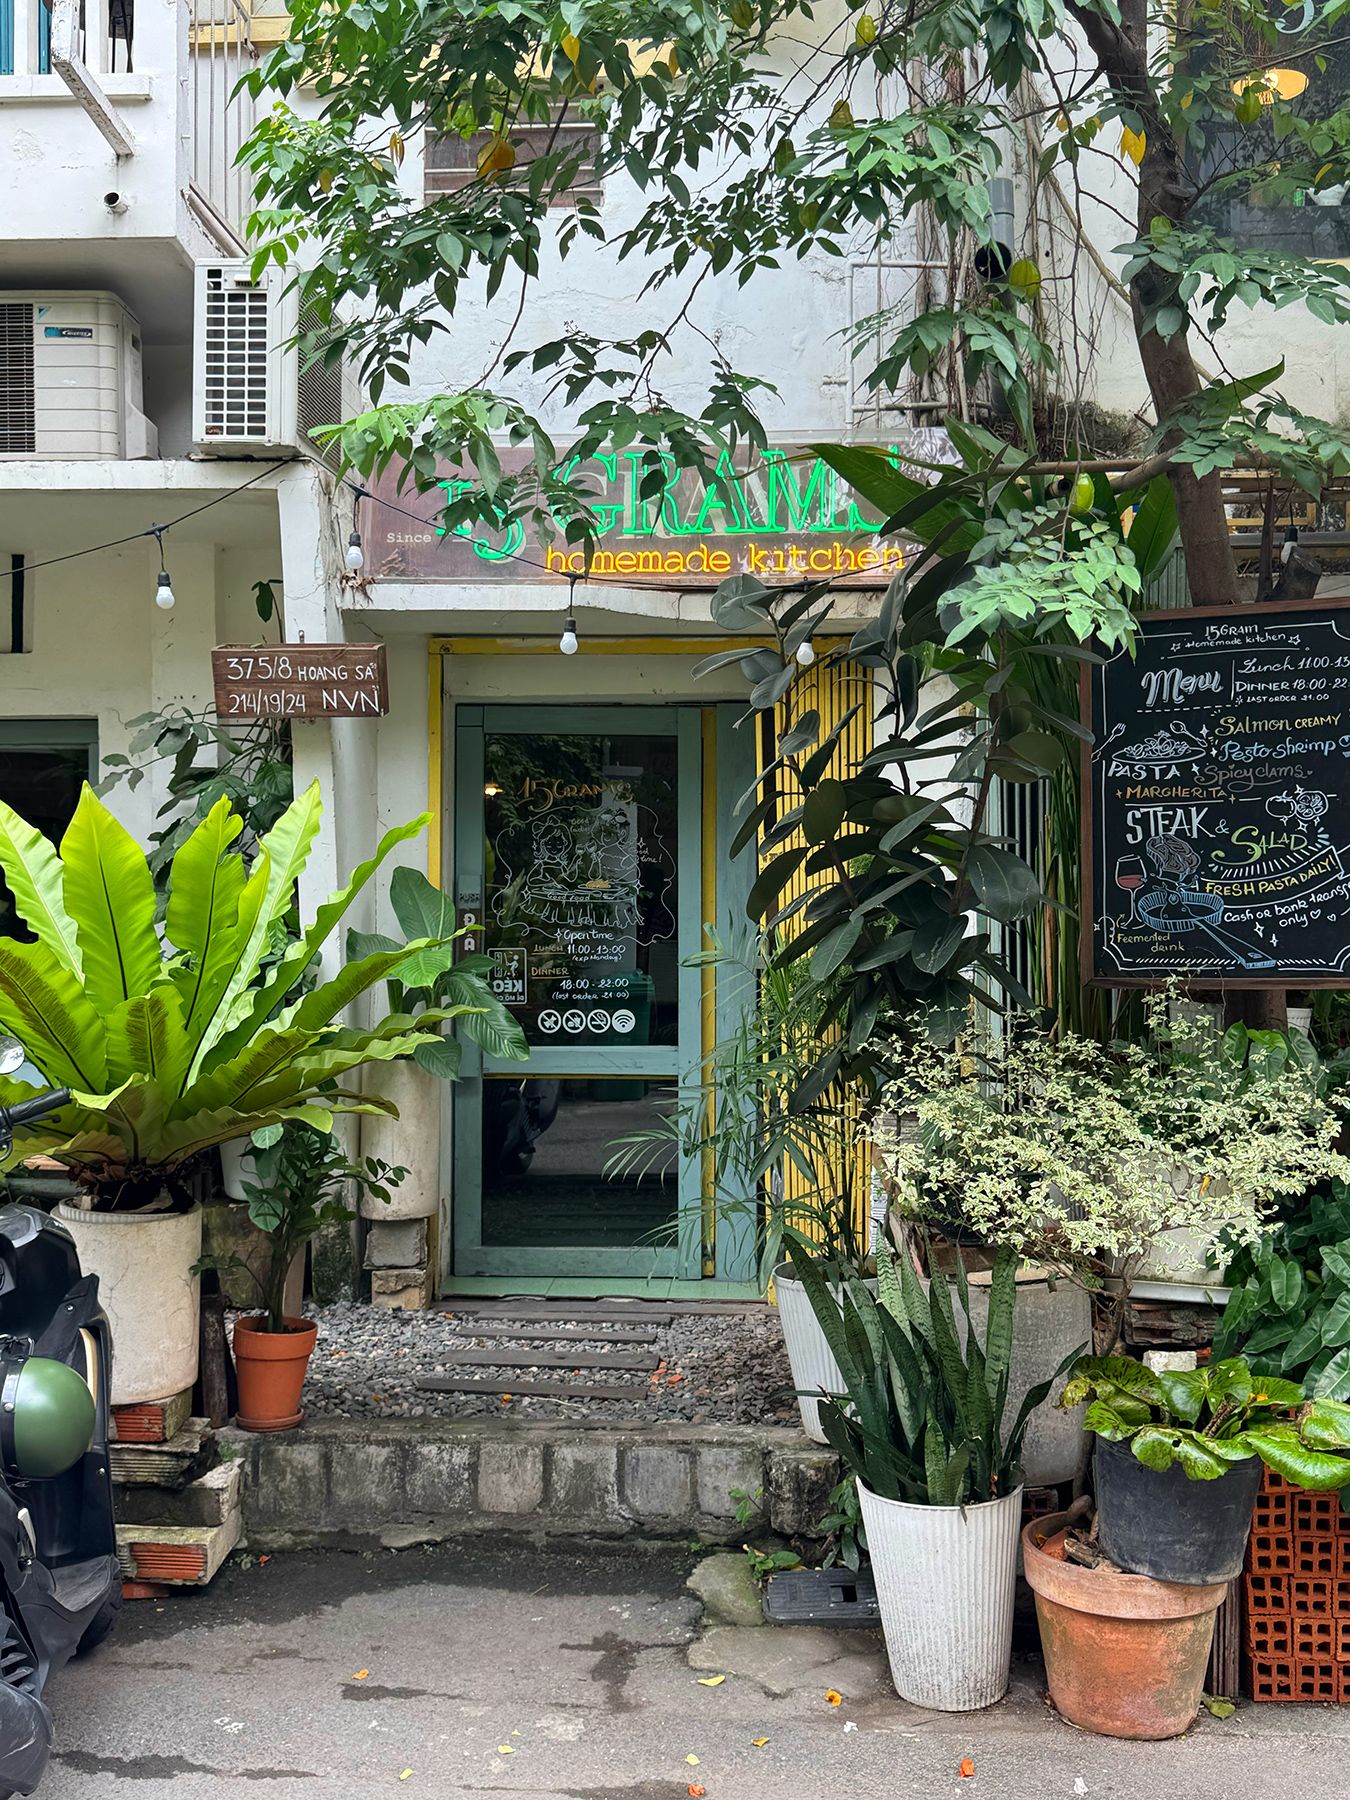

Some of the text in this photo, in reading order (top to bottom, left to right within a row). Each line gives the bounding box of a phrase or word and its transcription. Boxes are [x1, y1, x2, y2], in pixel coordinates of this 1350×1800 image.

[386, 532, 432, 543] Since
[544, 542, 906, 573] homemade kitchen
[1245, 632, 1286, 644] kitchen
[226, 656, 292, 680] 375/8
[297, 665, 348, 681] HOANG
[1237, 655, 1295, 674] Lunch
[1140, 667, 1224, 707] Menu
[1234, 680, 1290, 692] DINNER
[228, 689, 379, 715] 214/19/24 NVN
[1294, 712, 1342, 729] CREAMY
[1218, 740, 1272, 763] Pesto
[1107, 761, 1181, 781] PASTA
[1126, 785, 1228, 799] MARGHERITA
[1126, 807, 1216, 845] STEAK
[1215, 819, 1230, 834] &
[1205, 881, 1256, 897] FRESH
[1258, 876, 1299, 893] PASTA
[1274, 899, 1309, 915] bank
[1279, 913, 1309, 928] only
[563, 929, 590, 944] Open
[531, 966, 570, 976] DINNER
